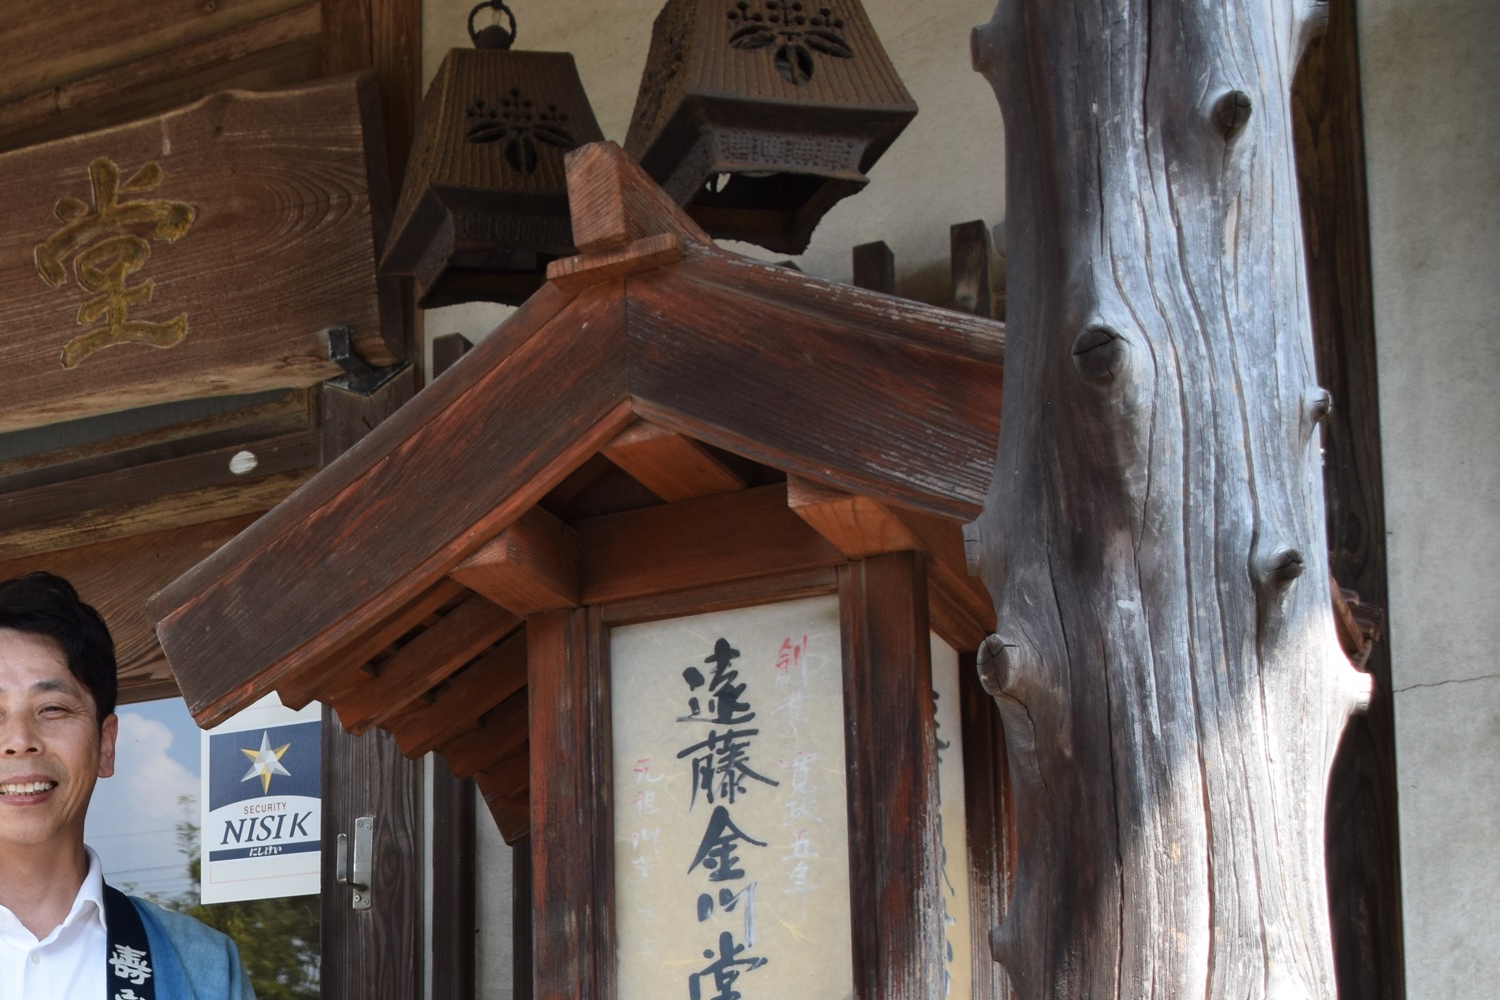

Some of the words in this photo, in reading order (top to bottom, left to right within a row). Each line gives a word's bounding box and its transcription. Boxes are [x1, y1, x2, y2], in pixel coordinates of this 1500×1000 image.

[243, 802, 287, 815] SECURITY
[249, 845, 282, 858] にしけい
